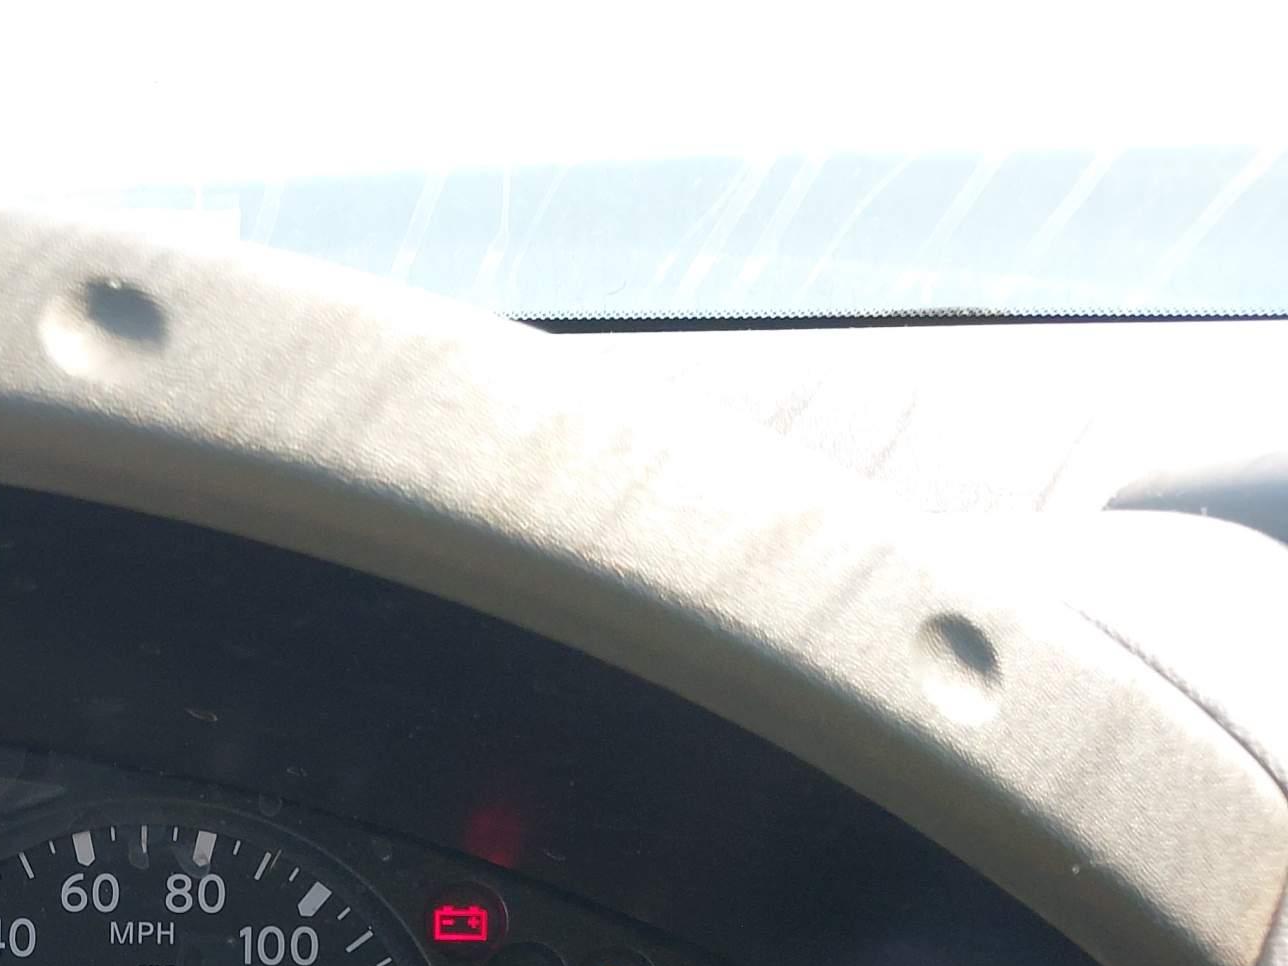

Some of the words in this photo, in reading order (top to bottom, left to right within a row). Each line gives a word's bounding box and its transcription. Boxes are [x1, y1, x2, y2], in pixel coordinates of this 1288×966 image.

[61, 873, 120, 913] 60
[165, 873, 226, 914] 80
[110, 921, 174, 945] MPH
[239, 925, 319, 966] 100
